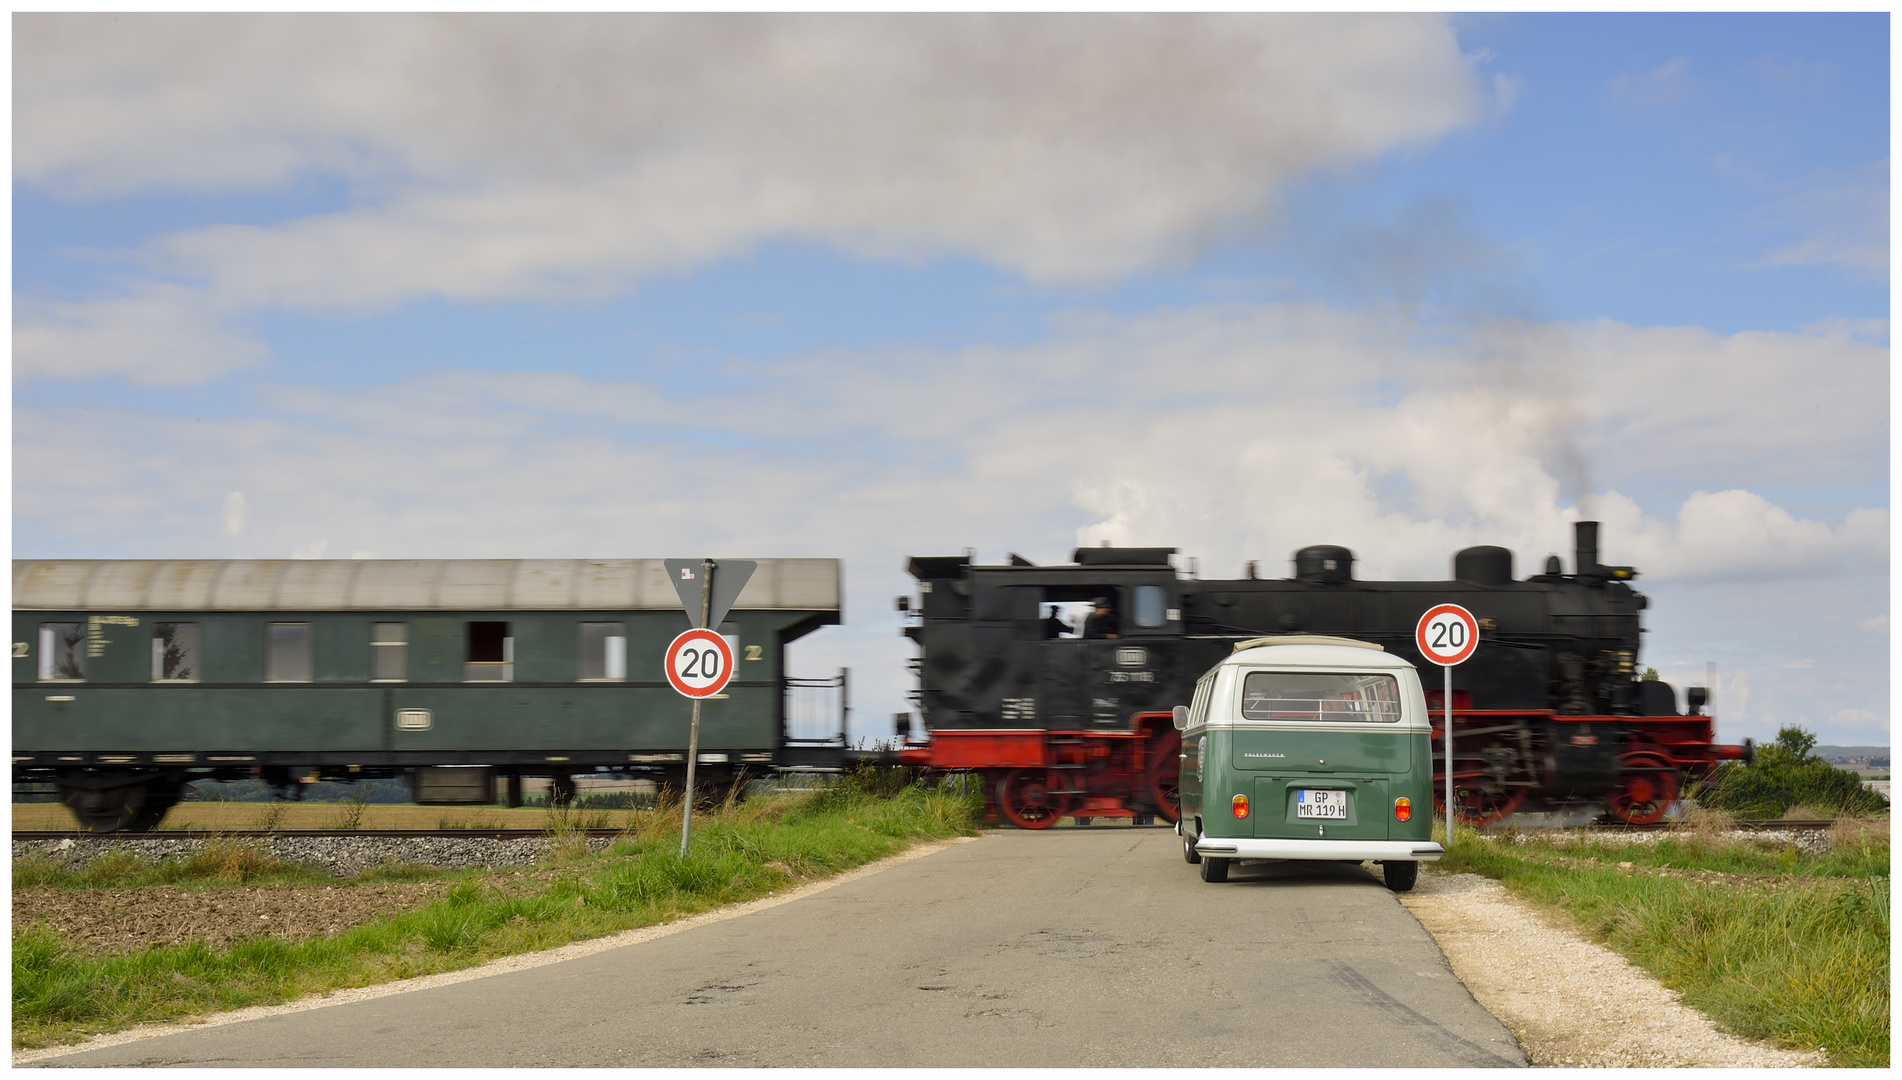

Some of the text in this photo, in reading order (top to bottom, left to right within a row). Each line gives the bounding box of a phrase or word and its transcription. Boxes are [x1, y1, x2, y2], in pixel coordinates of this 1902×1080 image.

[1432, 621, 1465, 648] 20
[682, 648, 718, 679] 20
[1315, 792, 1328, 803] GP
[1300, 805, 1345, 816] MR 119 H
